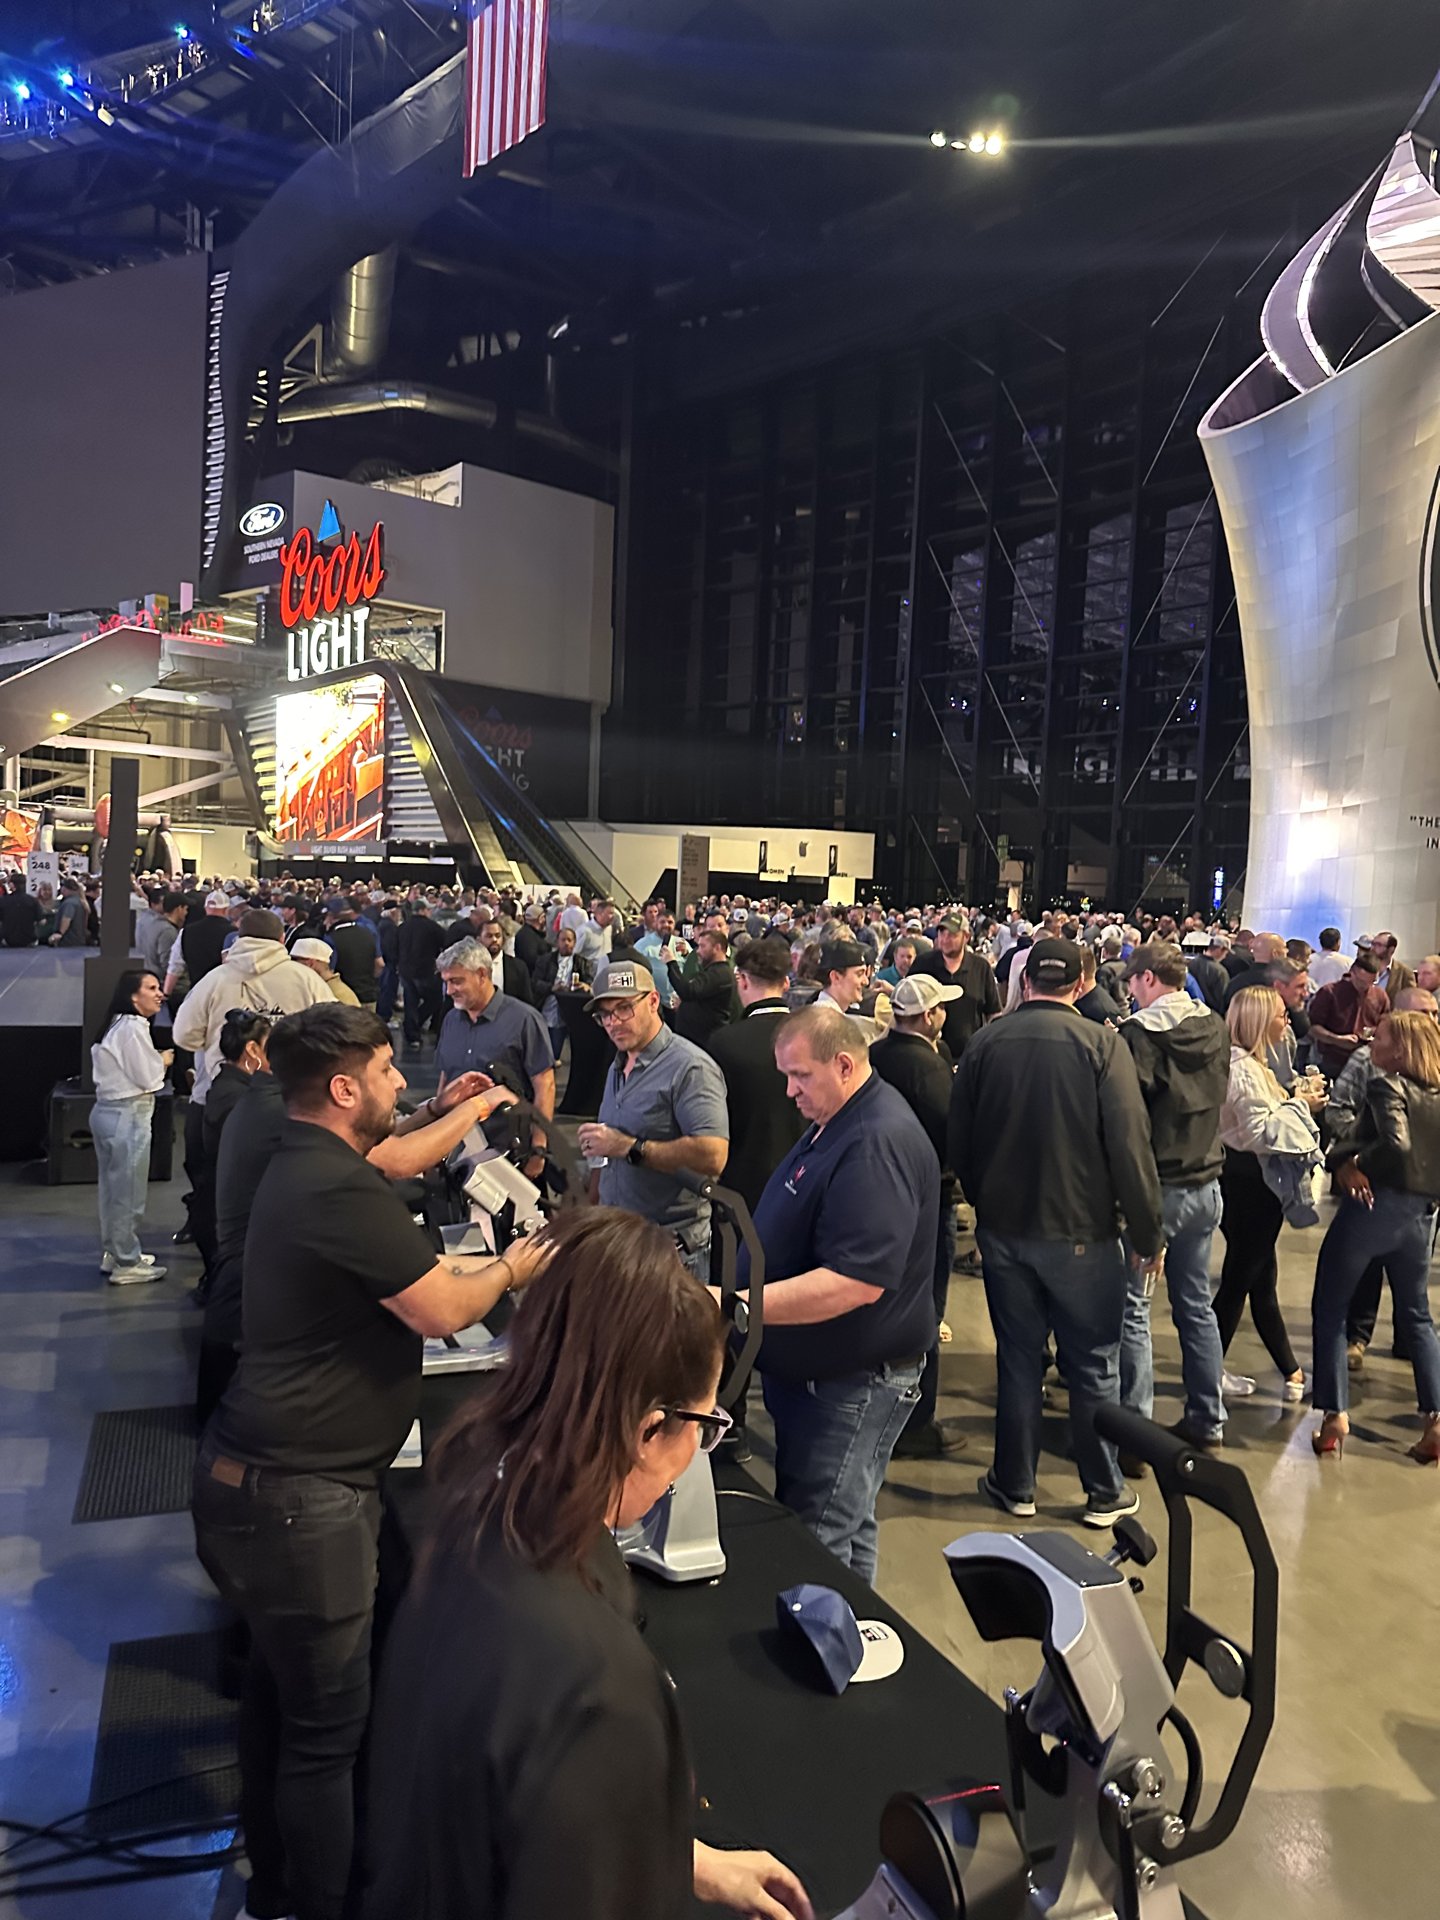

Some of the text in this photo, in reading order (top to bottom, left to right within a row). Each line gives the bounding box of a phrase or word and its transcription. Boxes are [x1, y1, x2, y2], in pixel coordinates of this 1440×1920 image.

[280, 521, 384, 628] Coors
[287, 606, 370, 682] LIGHT
[31, 861, 51, 870] 248
